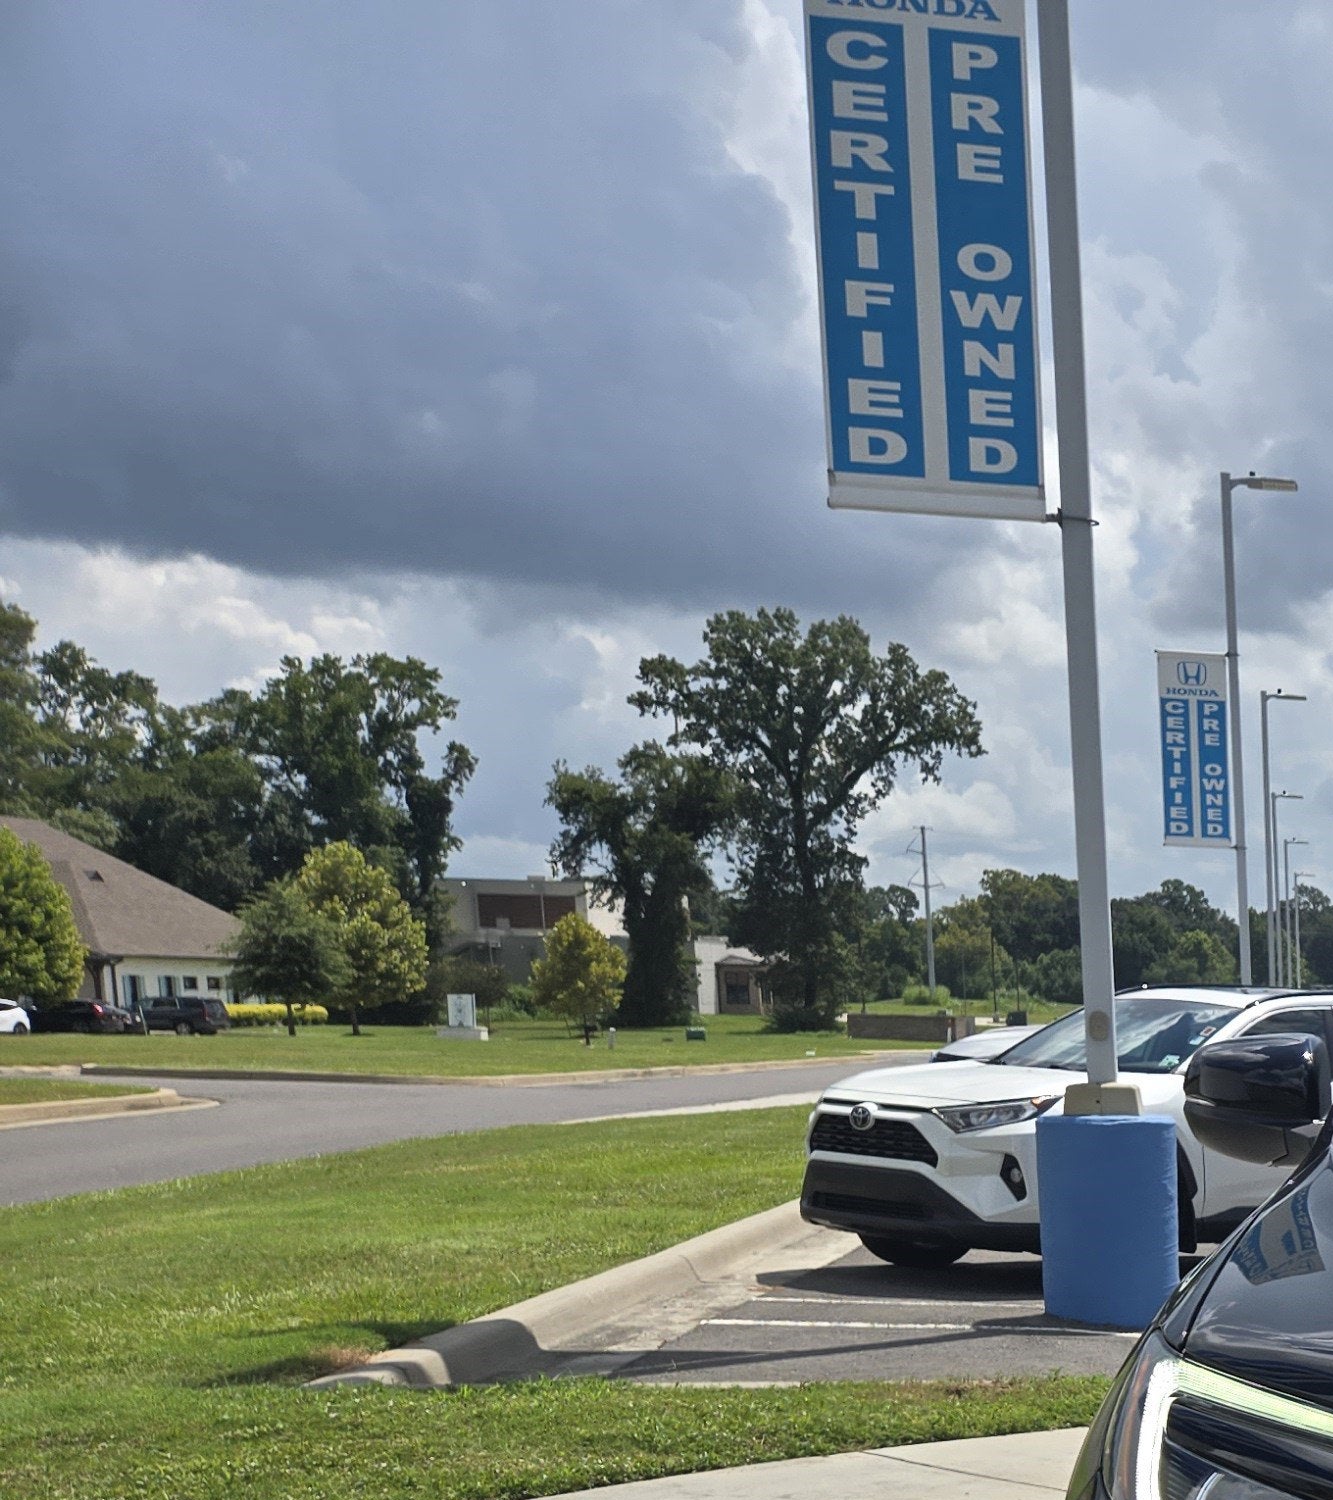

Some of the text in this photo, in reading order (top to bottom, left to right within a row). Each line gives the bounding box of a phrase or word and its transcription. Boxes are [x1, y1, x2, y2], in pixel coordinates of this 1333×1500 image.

[827, 0, 1002, 22] NDA
[826, 29, 908, 466] CERTIFIED
[949, 41, 1024, 475] PRE OWNED
[1165, 687, 1220, 698] HONDA
[1164, 700, 1190, 835] CERTIFIED
[1202, 703, 1226, 837] PRE OWNED
